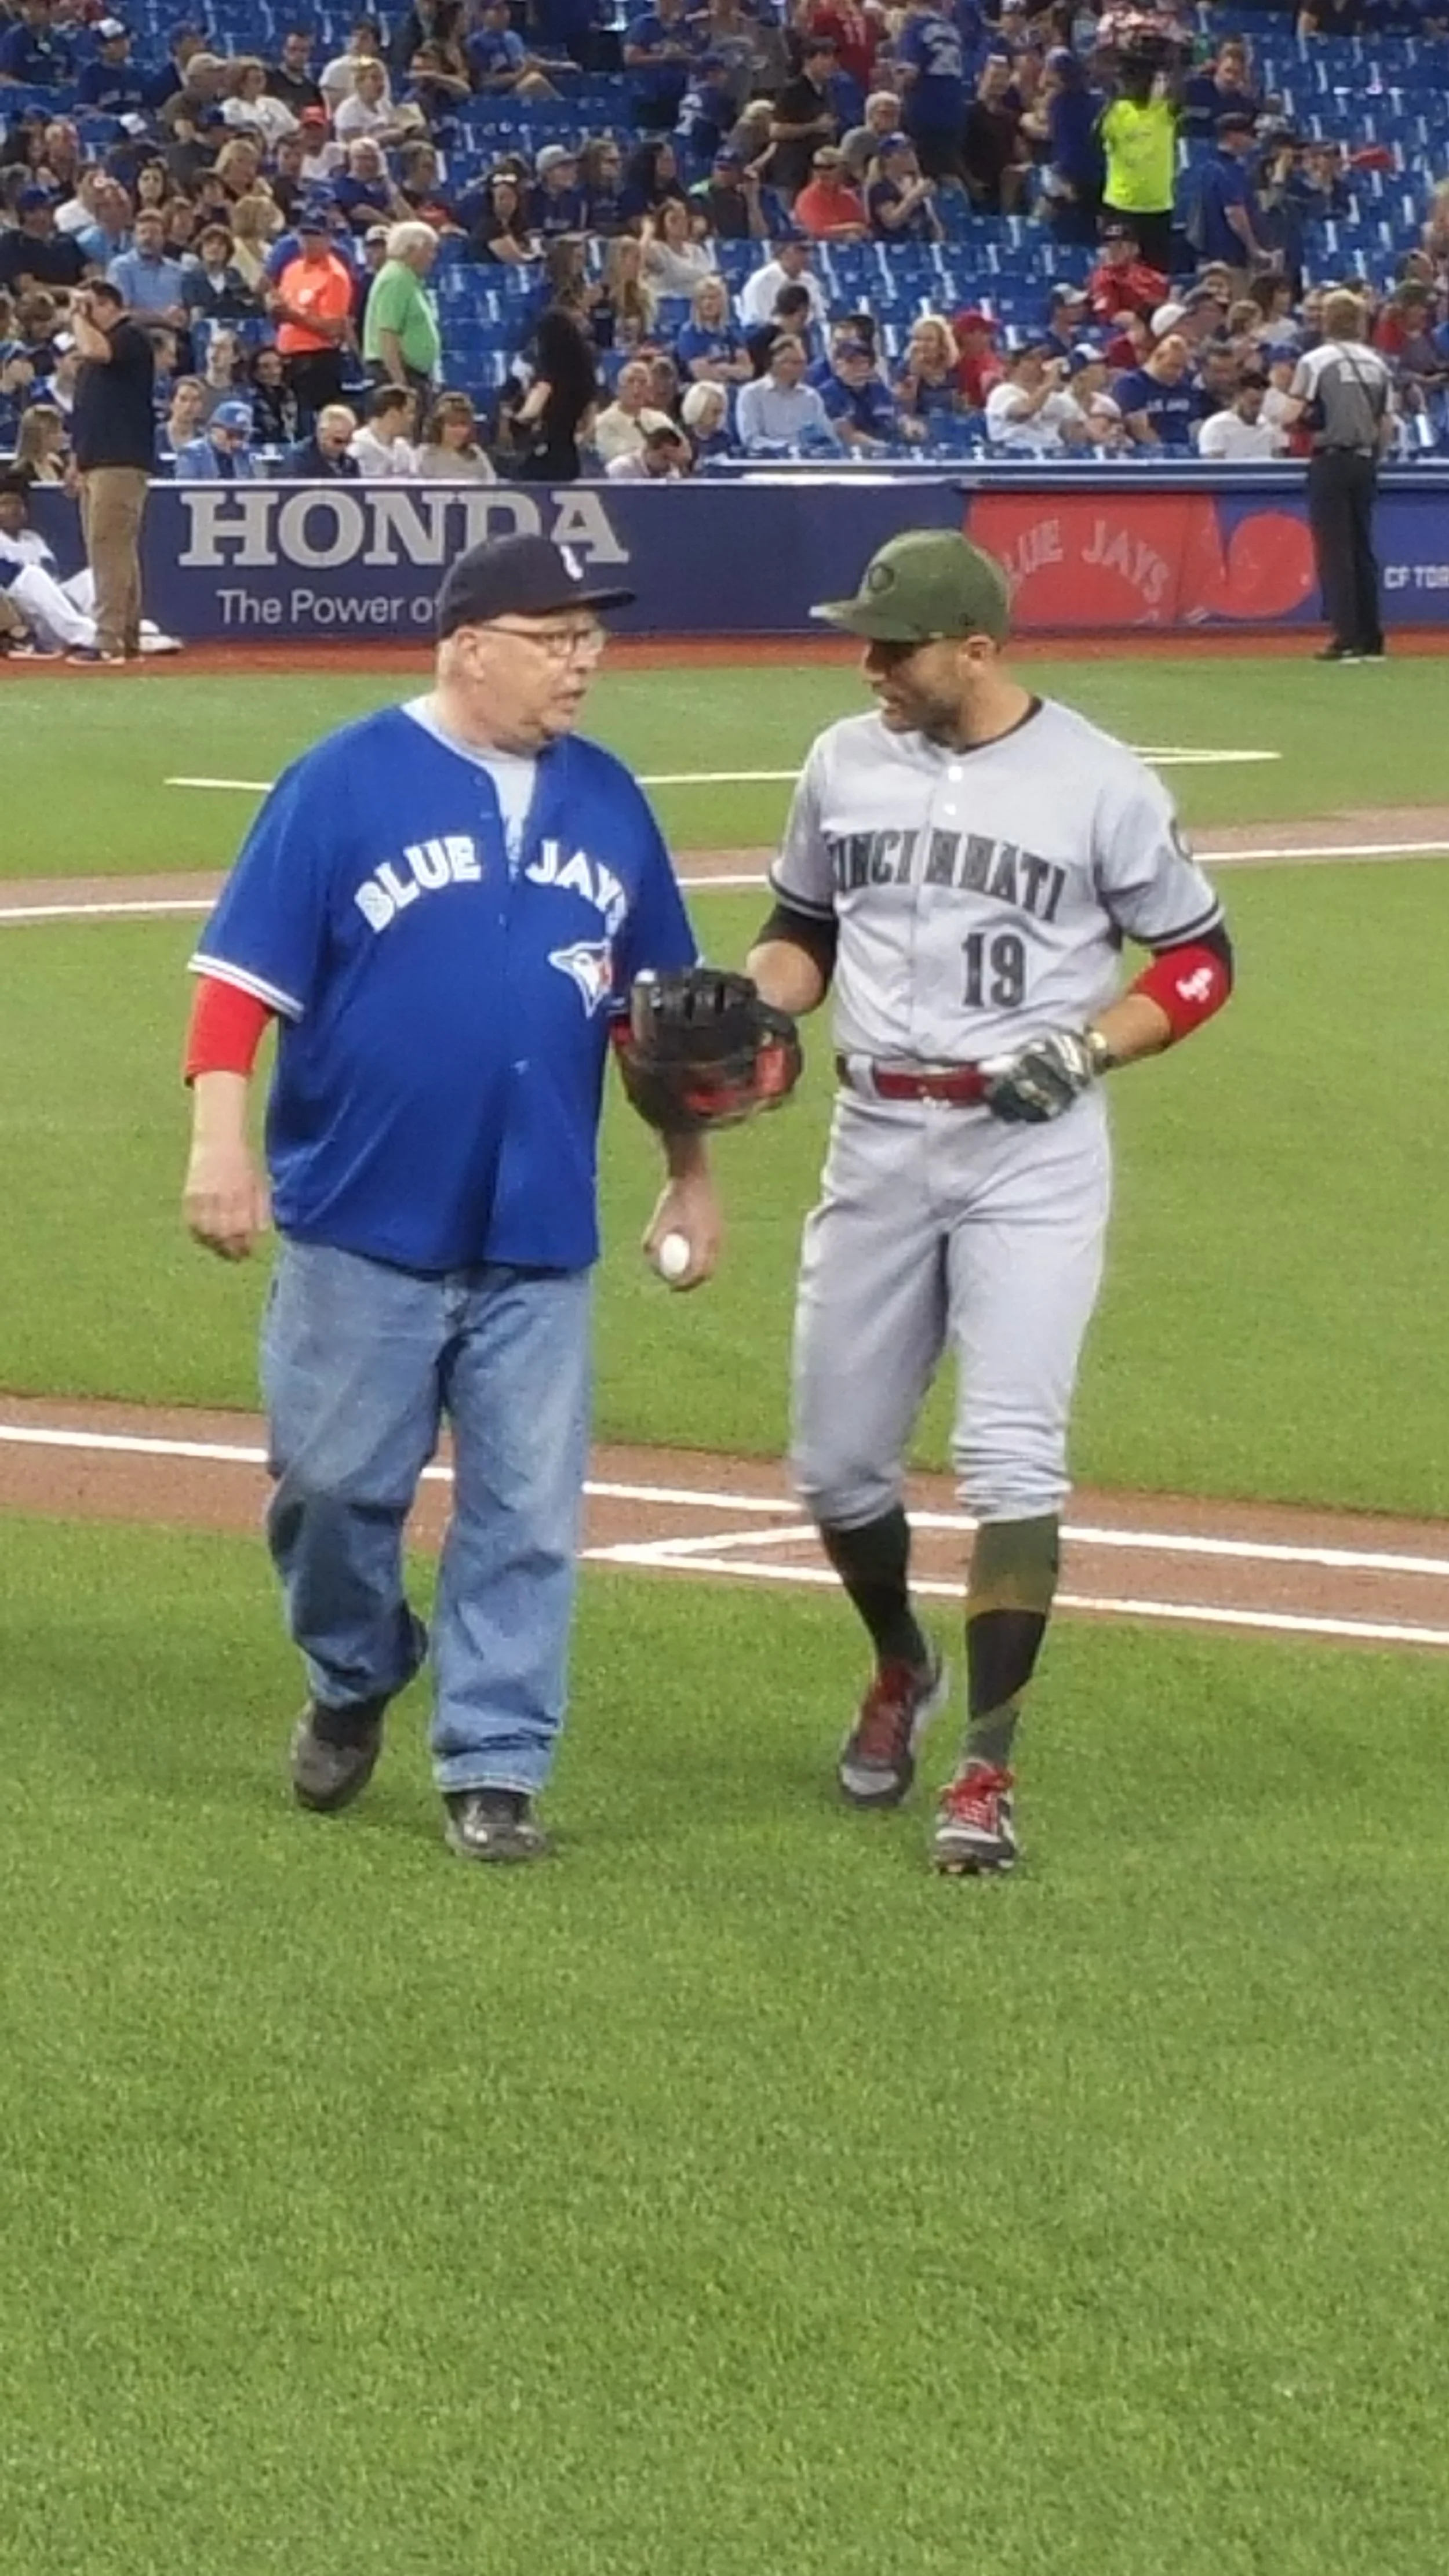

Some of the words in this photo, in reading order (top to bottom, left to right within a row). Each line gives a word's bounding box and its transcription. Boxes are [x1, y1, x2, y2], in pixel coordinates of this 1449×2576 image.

[179, 489, 631, 568] HONDA
[1080, 519, 1170, 604] JAYS
[215, 588, 282, 625] The
[291, 588, 404, 624] Power
[354, 835, 482, 933] BLUE
[961, 932, 1026, 1009] 19
